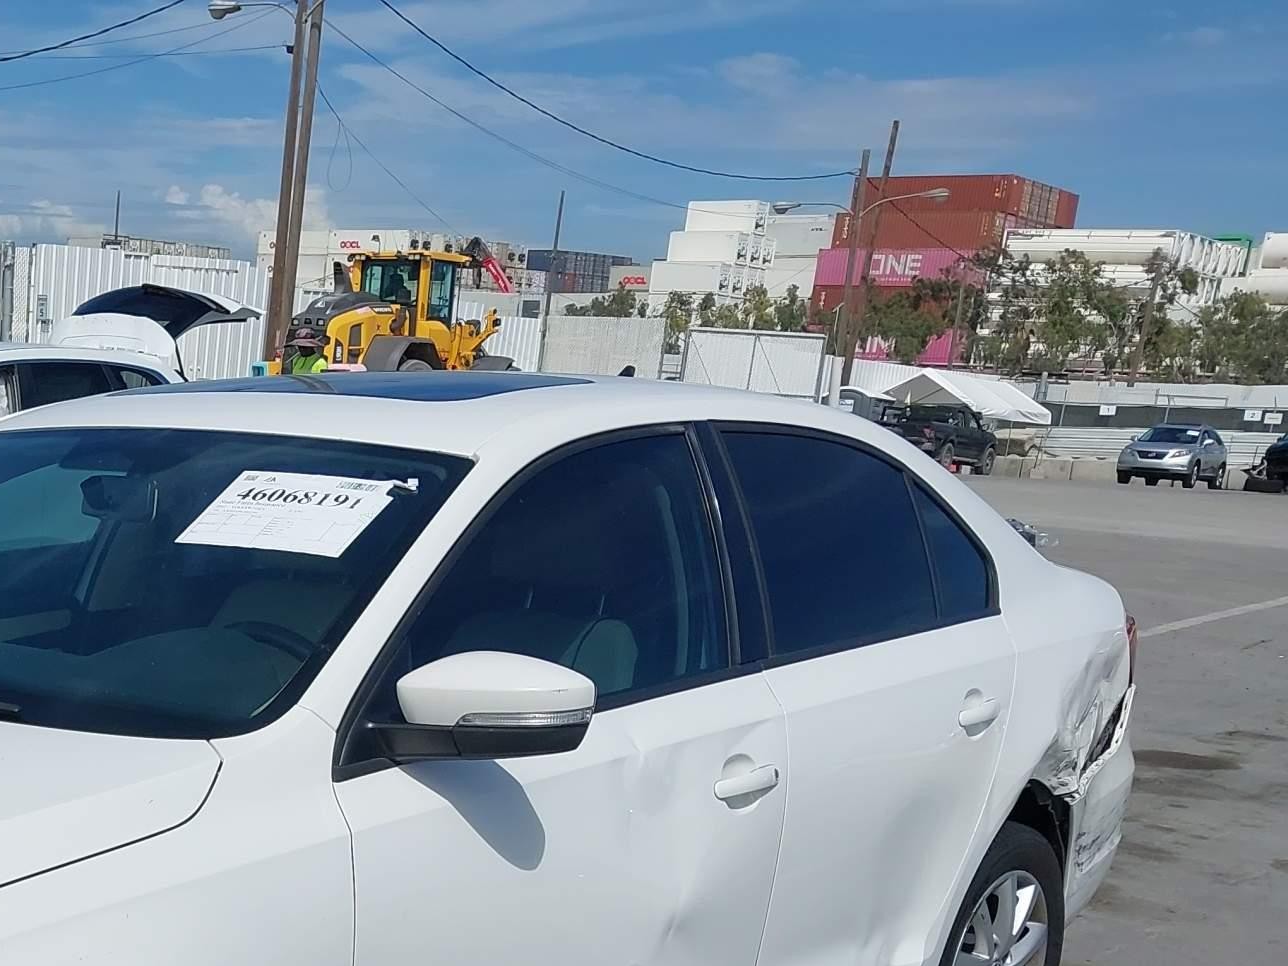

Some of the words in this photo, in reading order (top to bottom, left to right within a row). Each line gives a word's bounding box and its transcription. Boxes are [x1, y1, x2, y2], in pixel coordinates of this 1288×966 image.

[340, 240, 360, 248] OOCL
[869, 254, 922, 275] ONE
[623, 276, 647, 285] OOCL
[237, 487, 363, 509] 46068191
